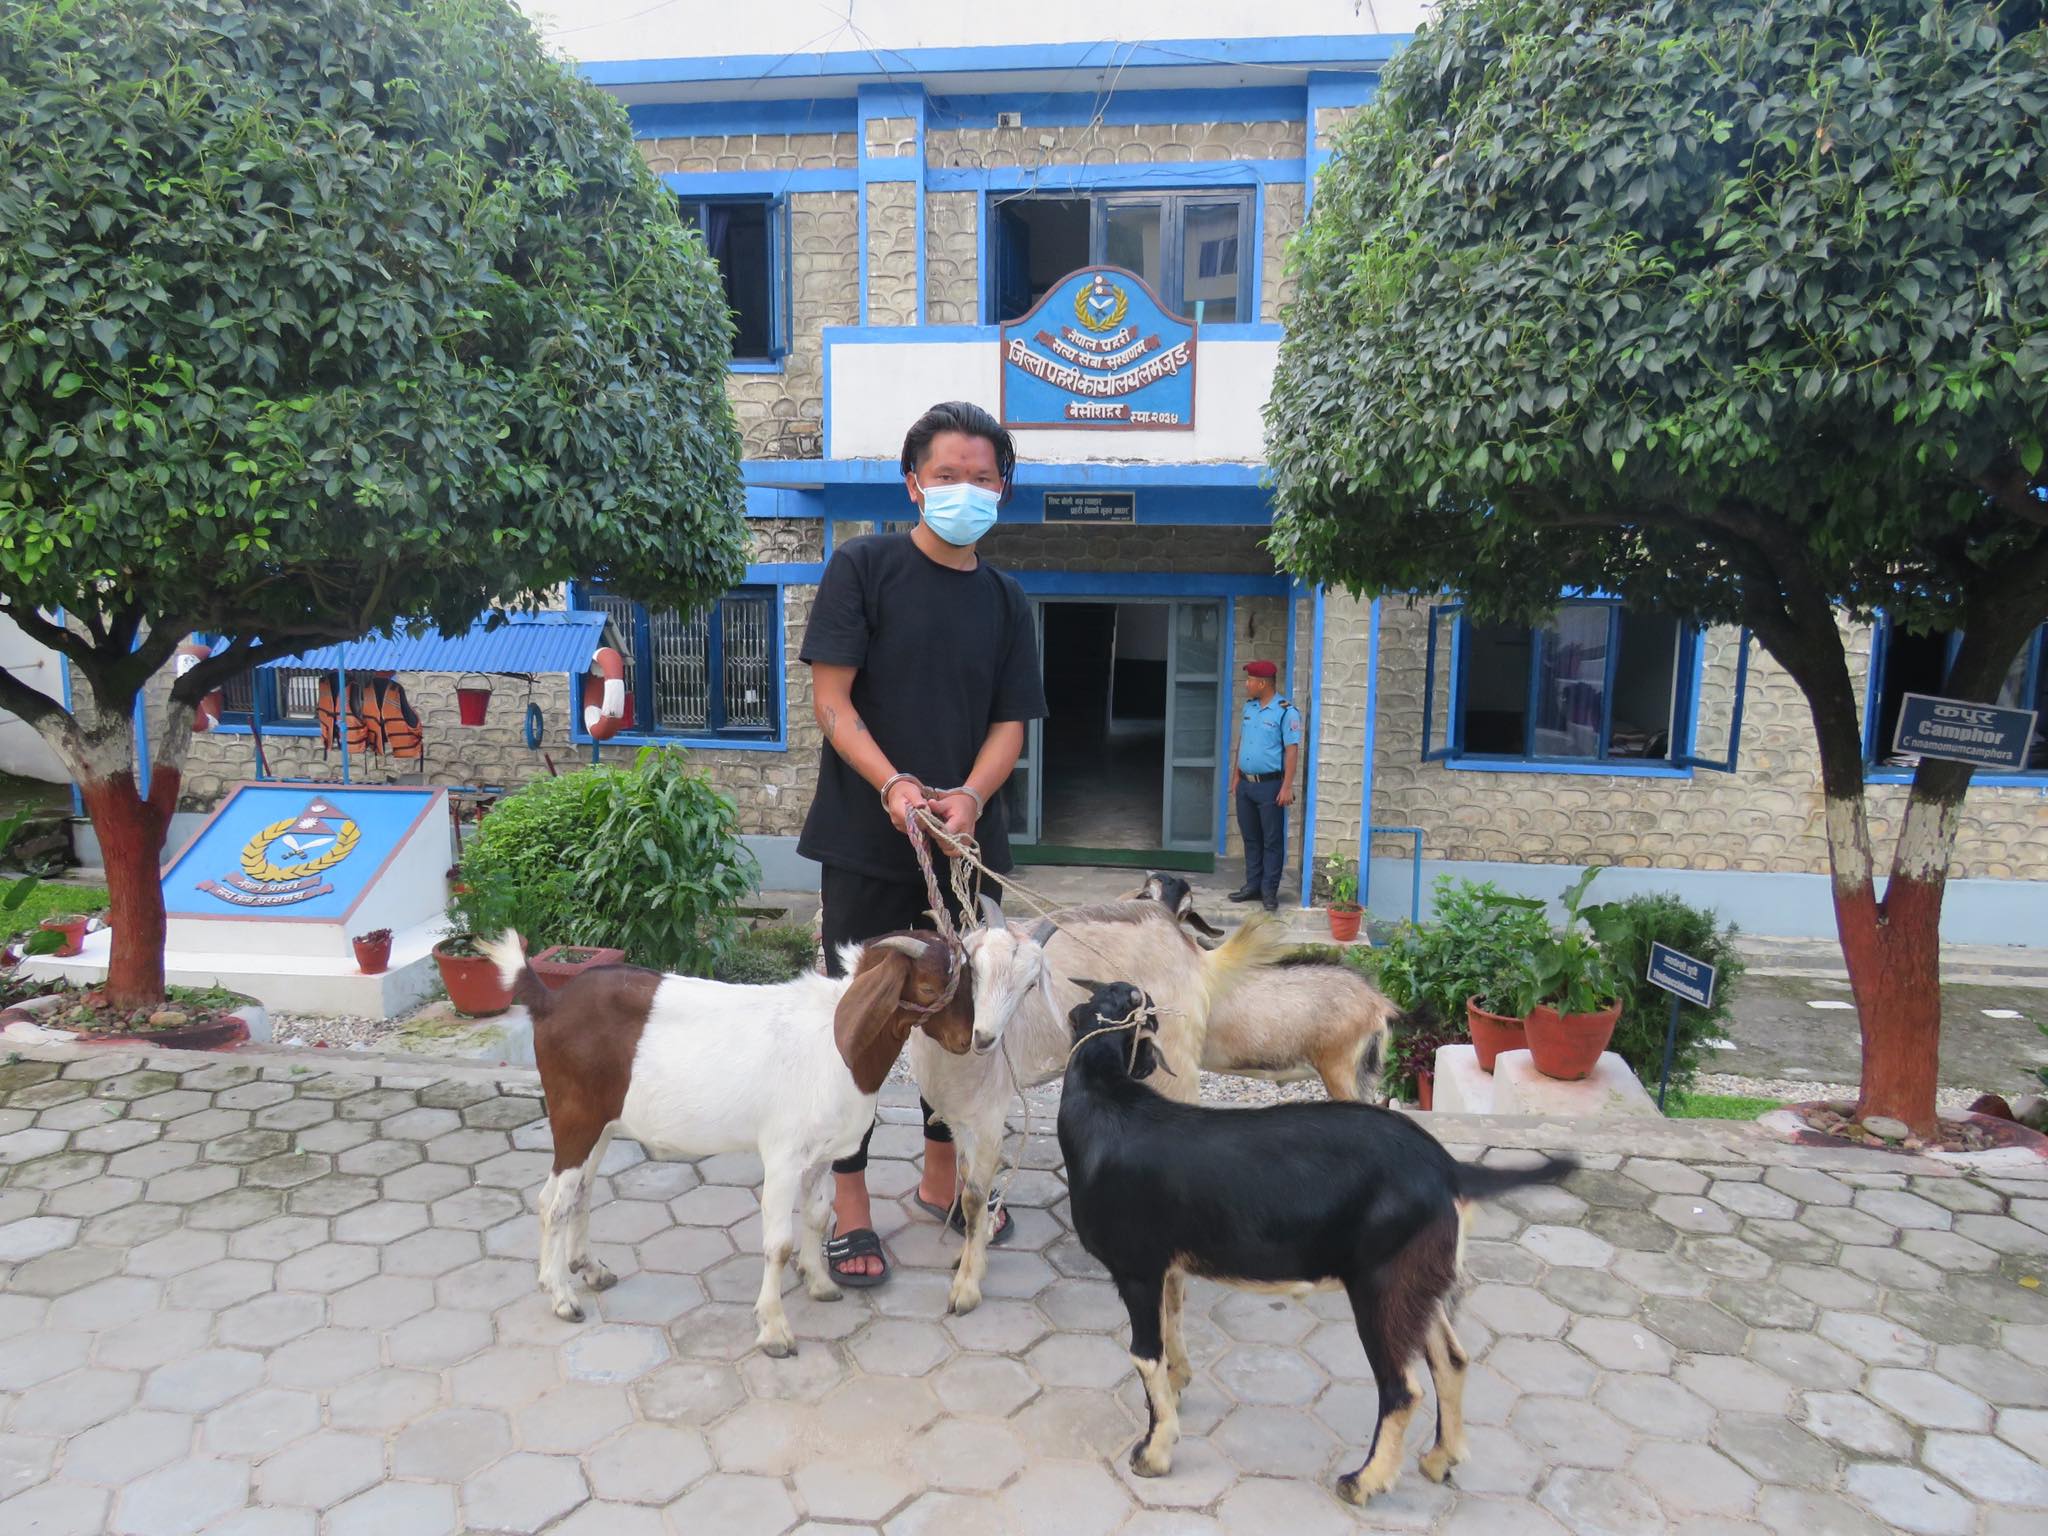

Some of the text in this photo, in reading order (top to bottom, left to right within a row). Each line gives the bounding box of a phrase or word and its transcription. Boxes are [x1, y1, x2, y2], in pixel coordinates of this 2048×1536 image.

[1067, 328, 1130, 351] नेपाल प्रहरी
[1052, 338, 1078, 361] सत्य
[1079, 351, 1103, 368] सेवा
[1933, 704, 1998, 724] कपुर
[1918, 720, 2006, 745] Camphor
[1902, 735, 2013, 760] Cnnamomumcamphora
